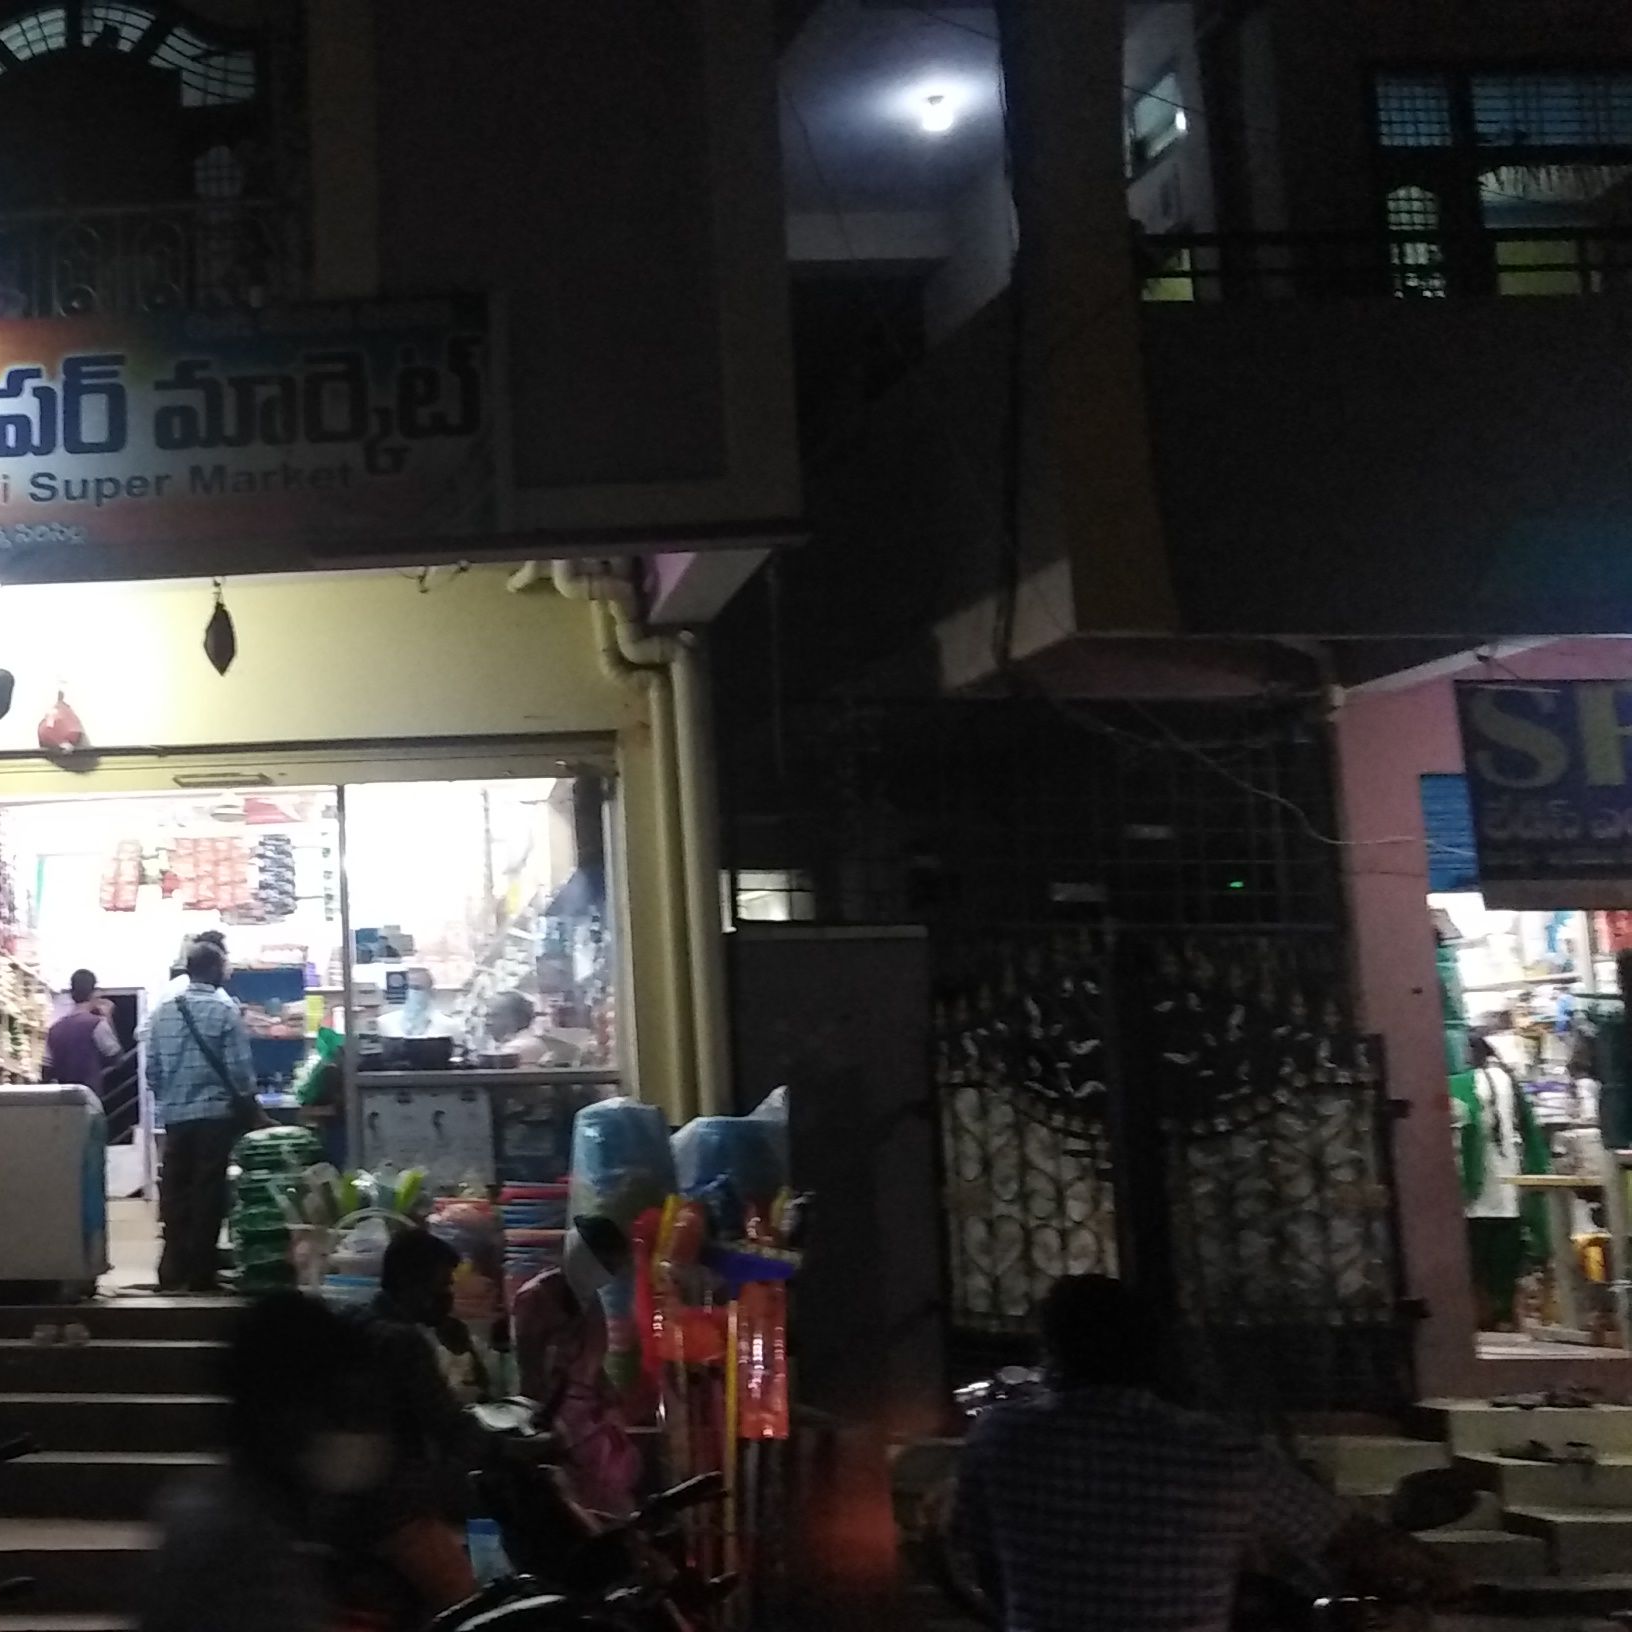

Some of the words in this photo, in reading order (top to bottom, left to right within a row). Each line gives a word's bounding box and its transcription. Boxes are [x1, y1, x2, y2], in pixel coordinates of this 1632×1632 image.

[154, 337, 482, 475] మార్కెట్
[28, 470, 172, 508] Super
[188, 460, 353, 498] Market
